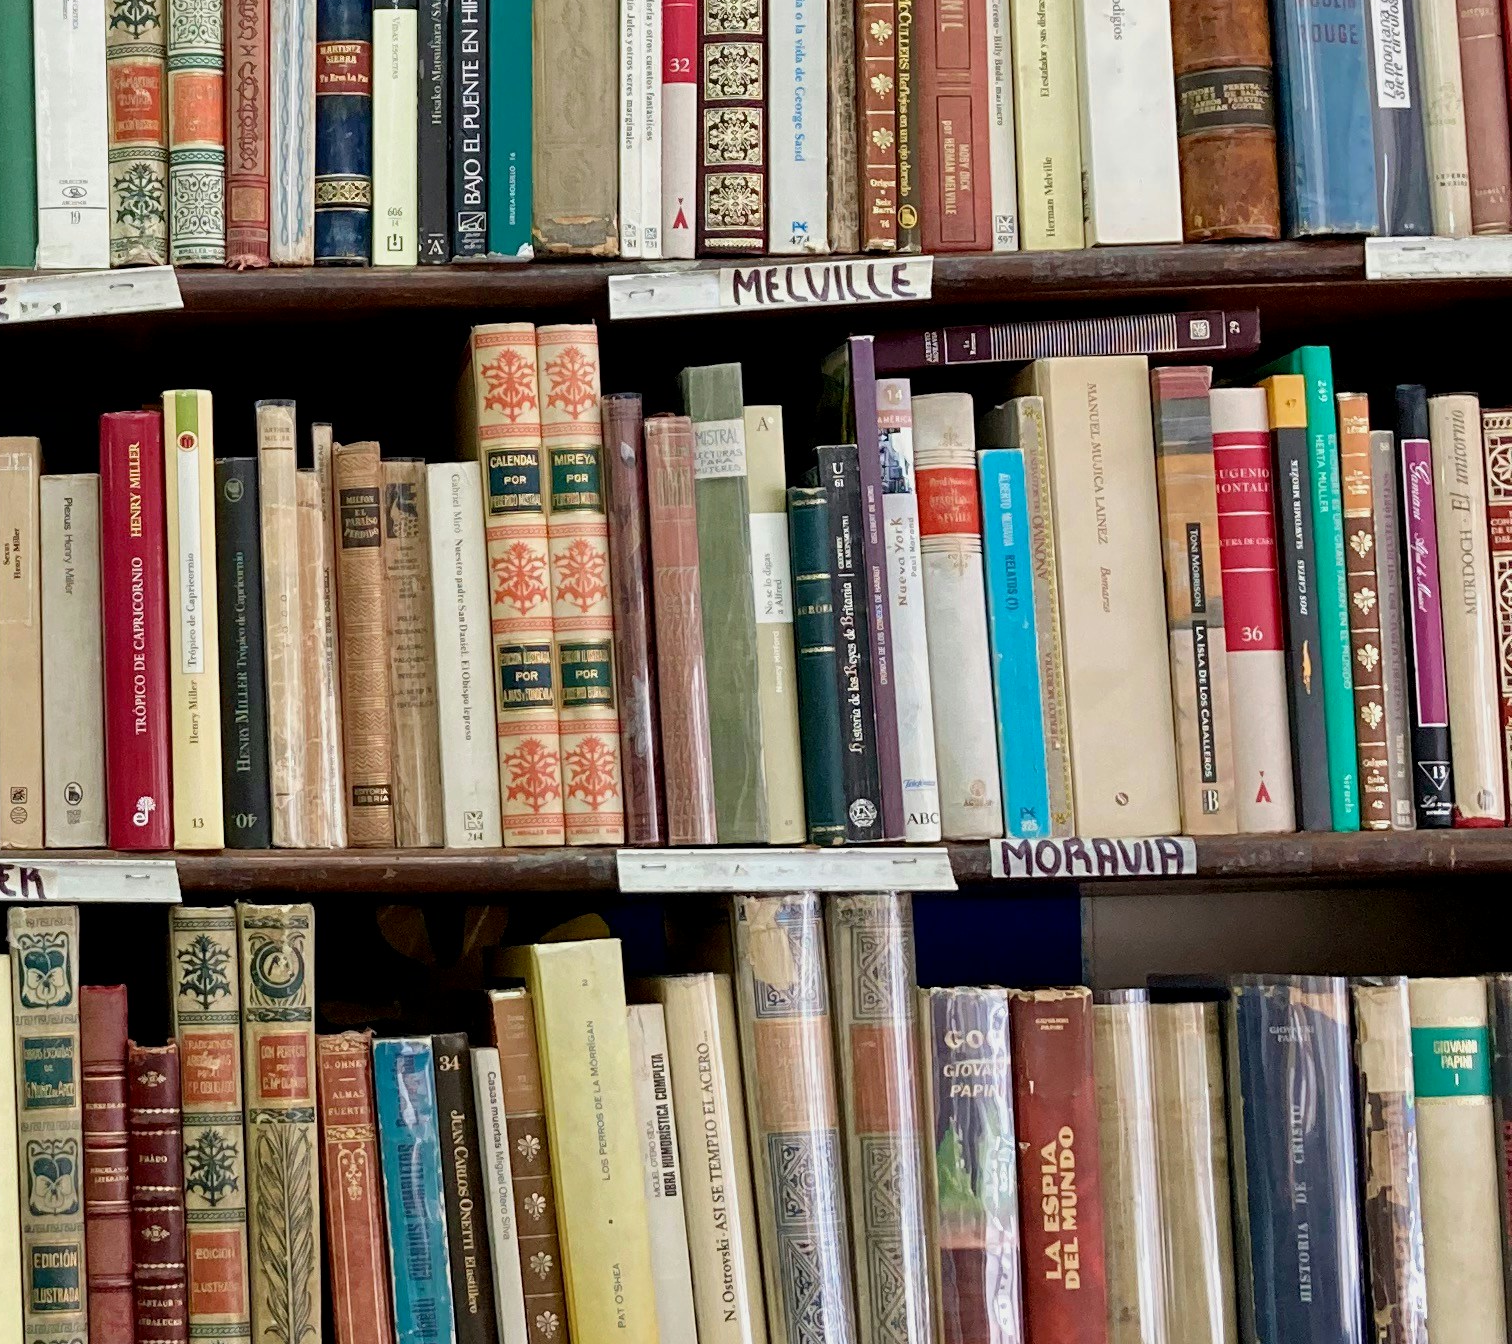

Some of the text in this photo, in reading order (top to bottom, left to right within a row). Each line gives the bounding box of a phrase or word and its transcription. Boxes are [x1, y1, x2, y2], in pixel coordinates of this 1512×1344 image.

[461, 28, 478, 53] EN
[669, 57, 690, 73] 32
[462, 59, 479, 127] PUENTE
[463, 128, 479, 152] EL
[463, 158, 481, 205] BAJO
[732, 260, 917, 305] MELVILLE
[490, 453, 539, 469] CALENDAL
[554, 453, 596, 465] MIREYA
[131, 556, 147, 736] TRÓPICO DE CAPRICORNIO
[1000, 838, 1189, 876] MORAVIA
[1041, 1140, 1061, 1281] LA ESPIA
[1058, 1125, 1080, 1290] DEL MUNDO
